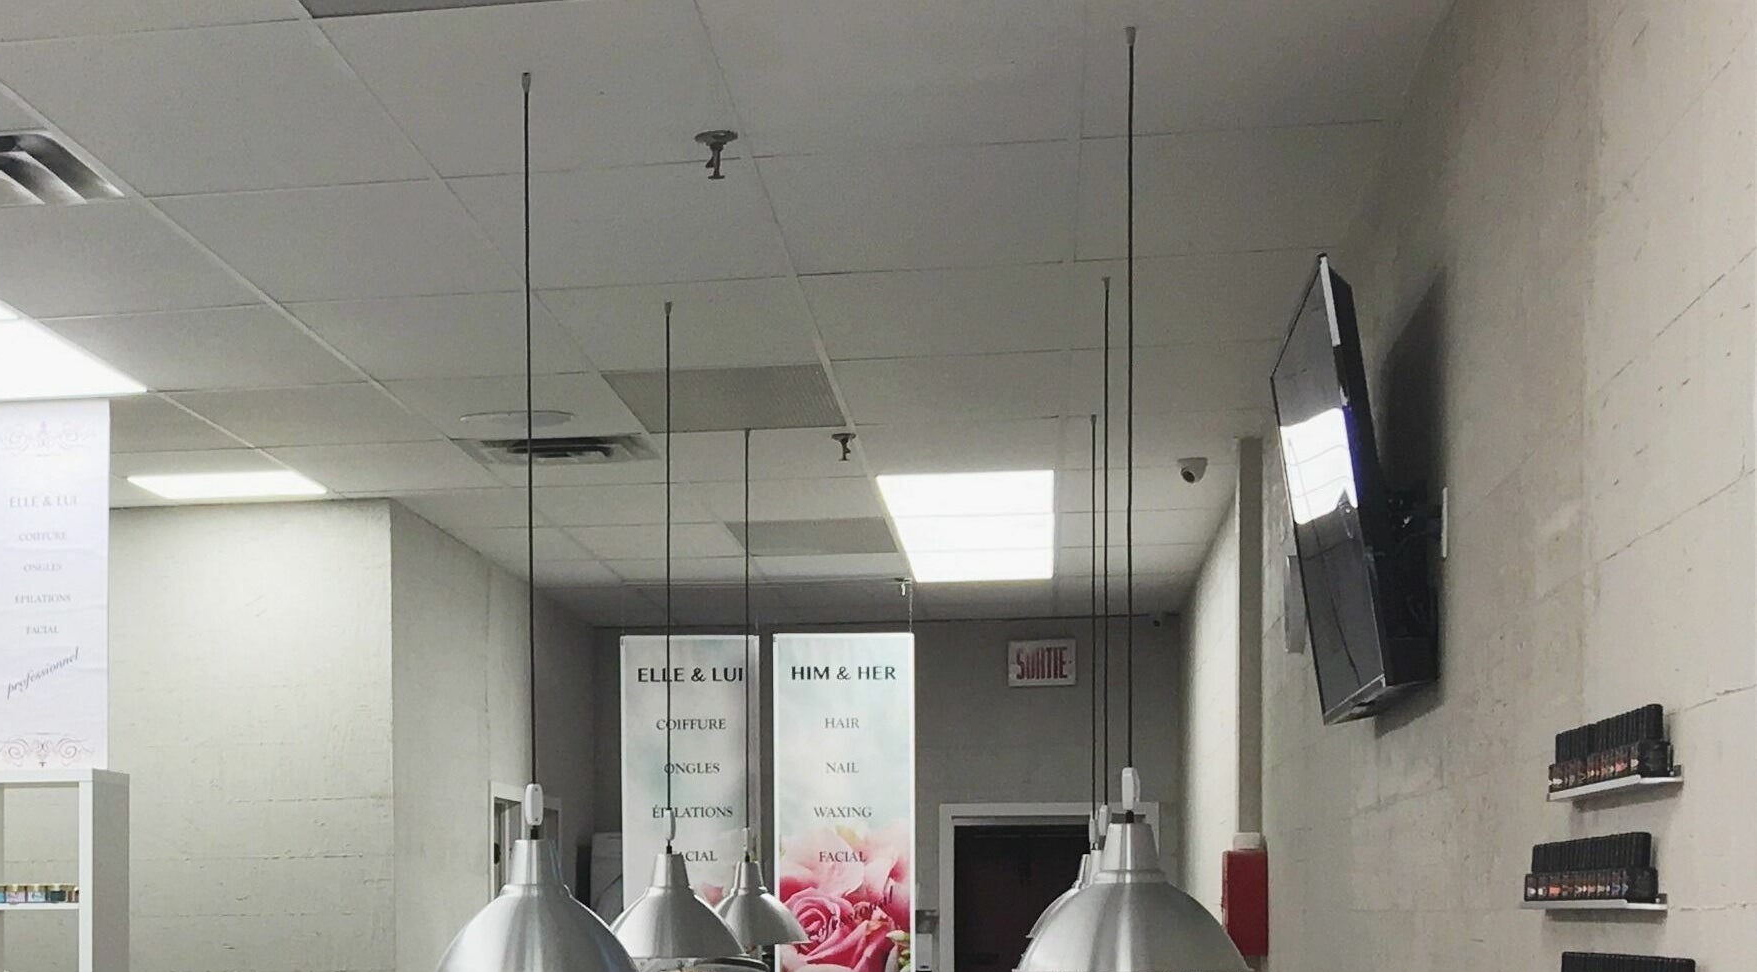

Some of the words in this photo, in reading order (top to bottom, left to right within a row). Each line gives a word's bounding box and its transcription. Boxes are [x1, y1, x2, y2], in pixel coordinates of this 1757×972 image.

[9, 495, 39, 509] ELLE
[43, 495, 53, 508] &
[25, 624, 60, 636] FACIAL
[1016, 647, 1068, 679] SORTIE
[6, 646, 79, 700] professionnel
[637, 667, 685, 682] ELLE
[690, 667, 706, 682] &
[712, 667, 745, 682] LUI
[791, 666, 830, 681] HIM
[836, 666, 852, 681] &
[857, 665, 897, 681] HER
[655, 718, 727, 730] COIFFURE
[824, 717, 860, 729] HAIR
[663, 762, 720, 774] ONGLES
[826, 762, 860, 774] NAIL
[651, 804, 734, 819] ÉPLATIONS
[813, 806, 873, 818] WAXING
[818, 851, 868, 863] FACIAL
